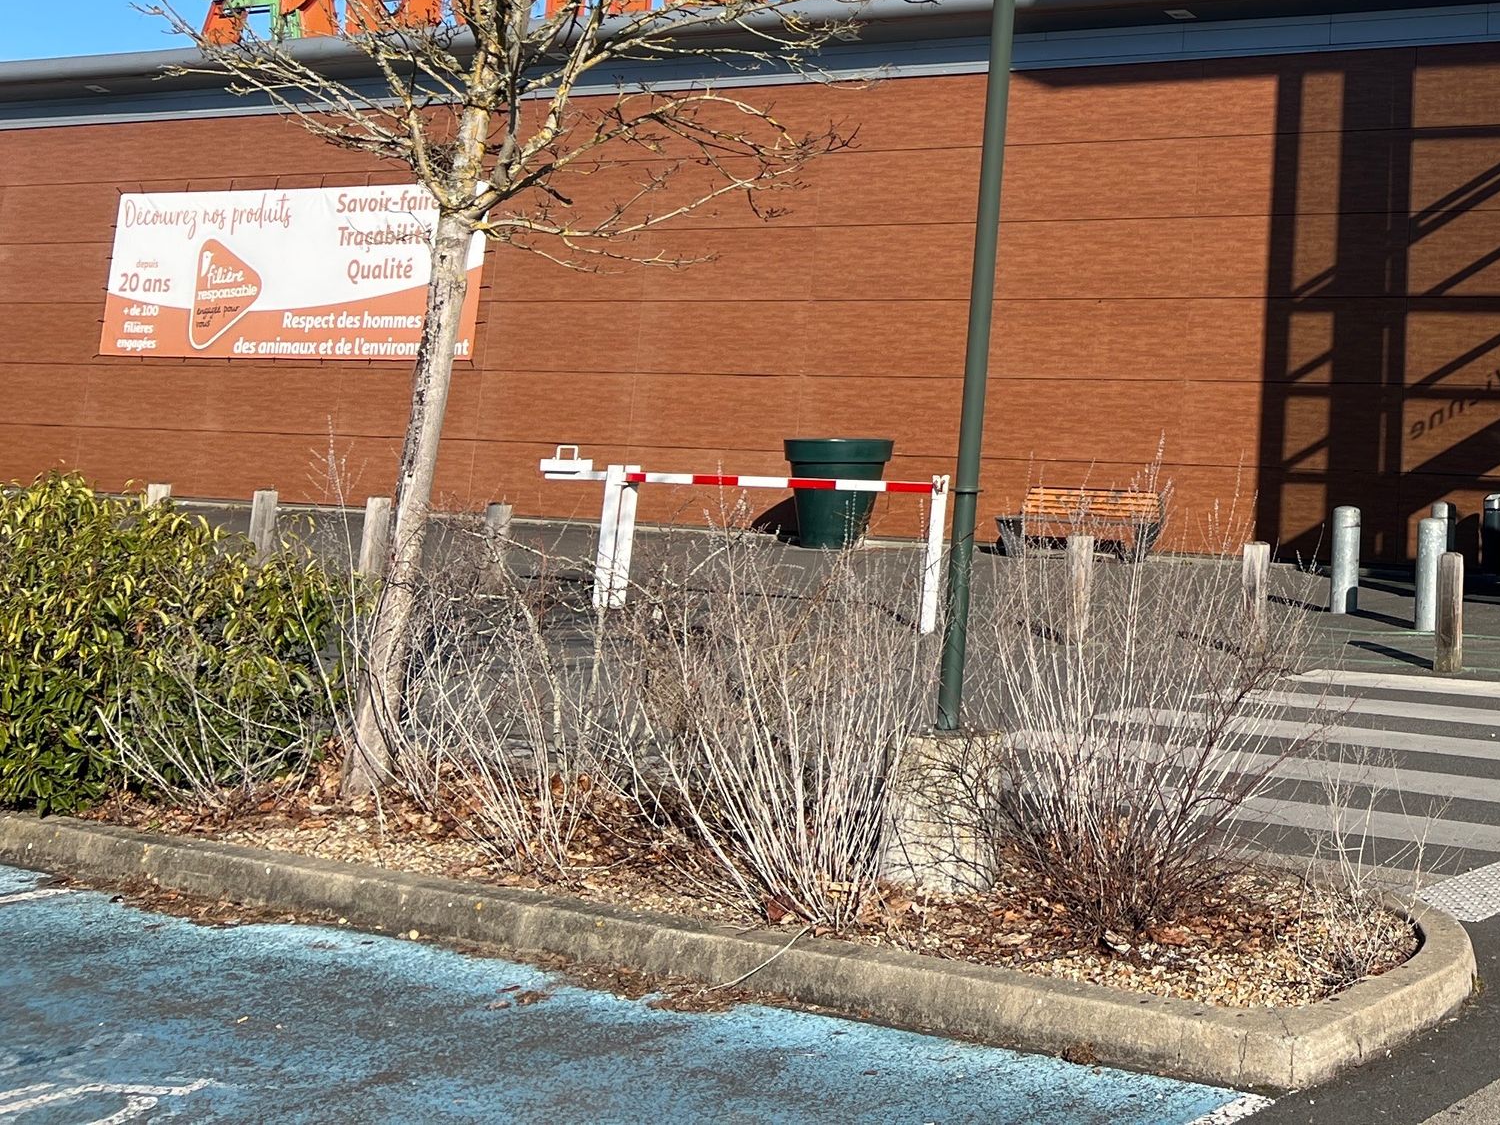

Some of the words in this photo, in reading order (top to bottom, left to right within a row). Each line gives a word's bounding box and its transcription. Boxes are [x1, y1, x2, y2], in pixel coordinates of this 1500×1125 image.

[125, 199, 197, 240] Découvrez
[202, 207, 227, 230] nos
[230, 193, 292, 236] produits
[136, 258, 159, 270] depuis
[347, 258, 413, 284] Qualité
[118, 272, 140, 293] 20
[142, 277, 171, 293] ans
[207, 264, 245, 288] filière
[196, 283, 258, 302] responsable
[129, 305, 141, 316] de
[141, 305, 160, 317] 100
[223, 304, 241, 318] pour
[123, 320, 154, 334] filières
[282, 311, 336, 333] Respect
[336, 311, 360, 329] des
[363, 311, 422, 329] hommes
[116, 338, 157, 352] engagées
[233, 337, 256, 355] des
[258, 339, 317, 355] animaux
[319, 339, 334, 355] et
[335, 337, 353, 355] de
[354, 337, 469, 355] l'environnt
